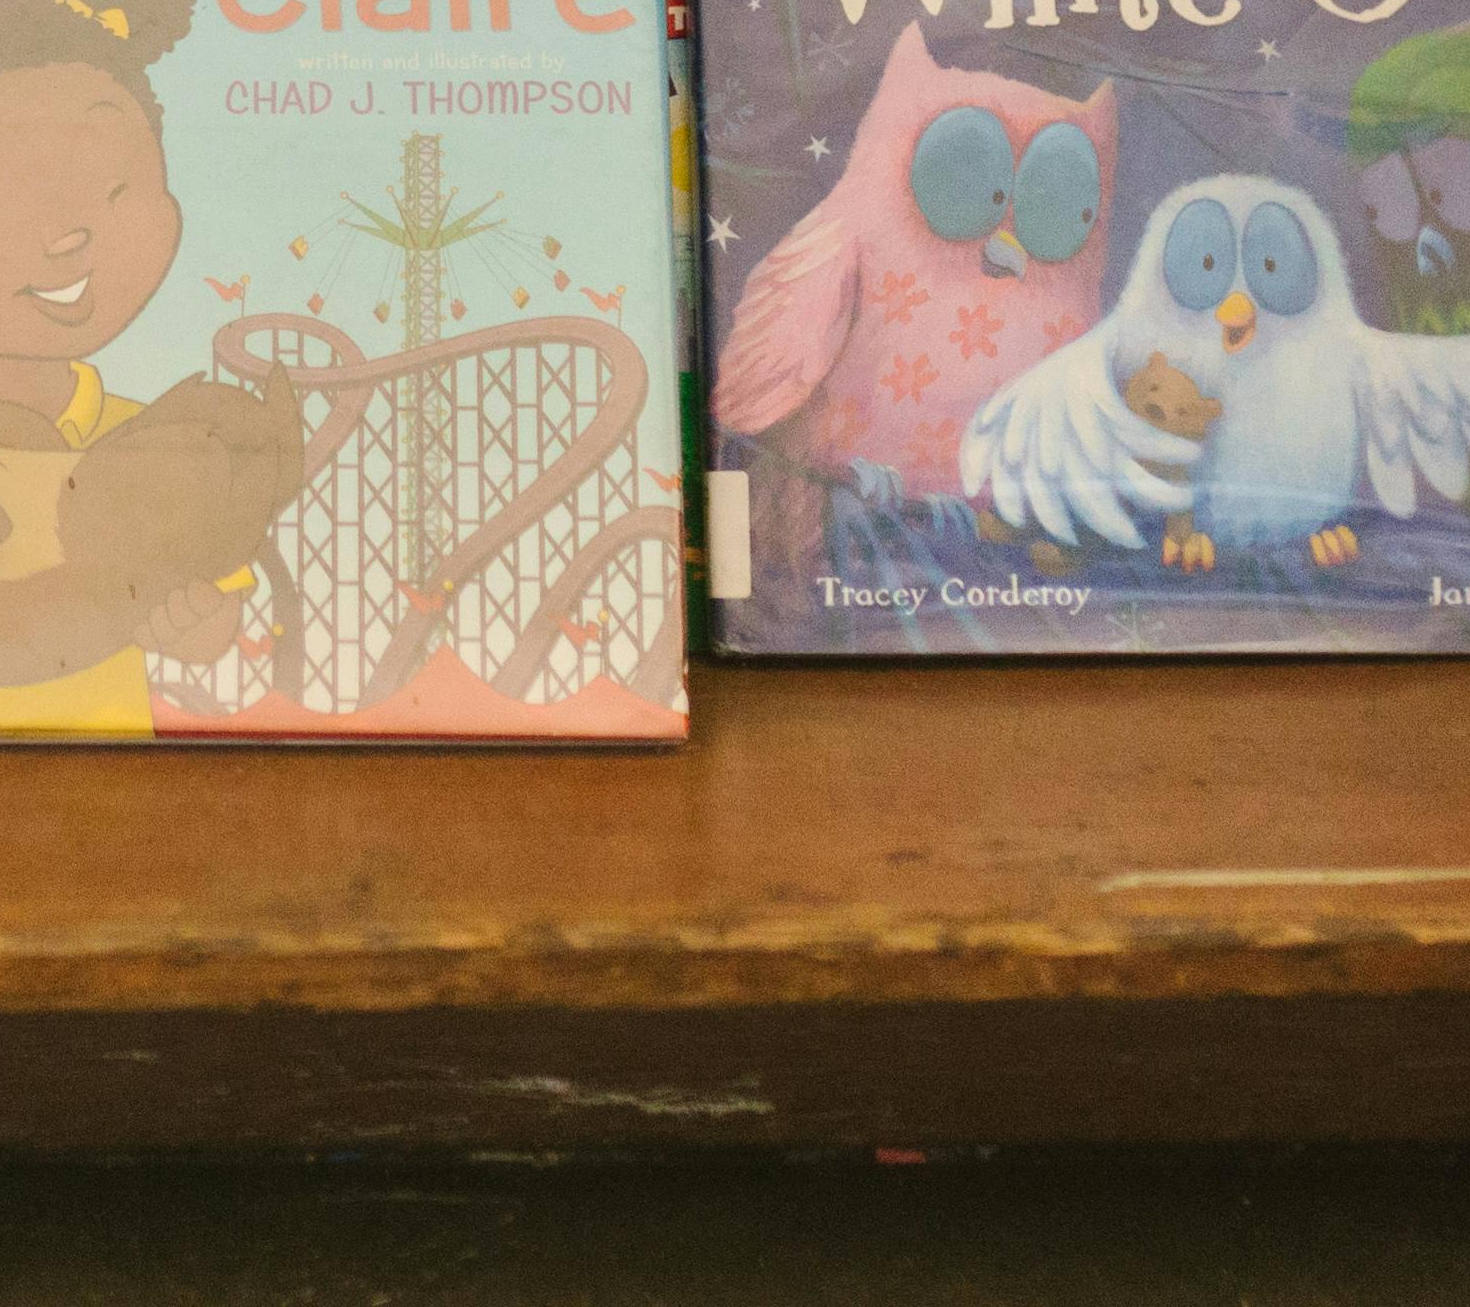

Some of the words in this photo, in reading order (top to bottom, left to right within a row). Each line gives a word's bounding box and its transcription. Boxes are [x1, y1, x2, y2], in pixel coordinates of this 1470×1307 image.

[296, 50, 375, 74] written
[378, 50, 423, 74] and
[427, 49, 532, 74] illustrated
[536, 50, 567, 77] by
[224, 79, 336, 119] CHAD
[348, 79, 388, 118] J.
[405, 79, 634, 118] THOMPSON
[815, 575, 928, 609] Tracey
[938, 573, 1094, 611] Corderoy
